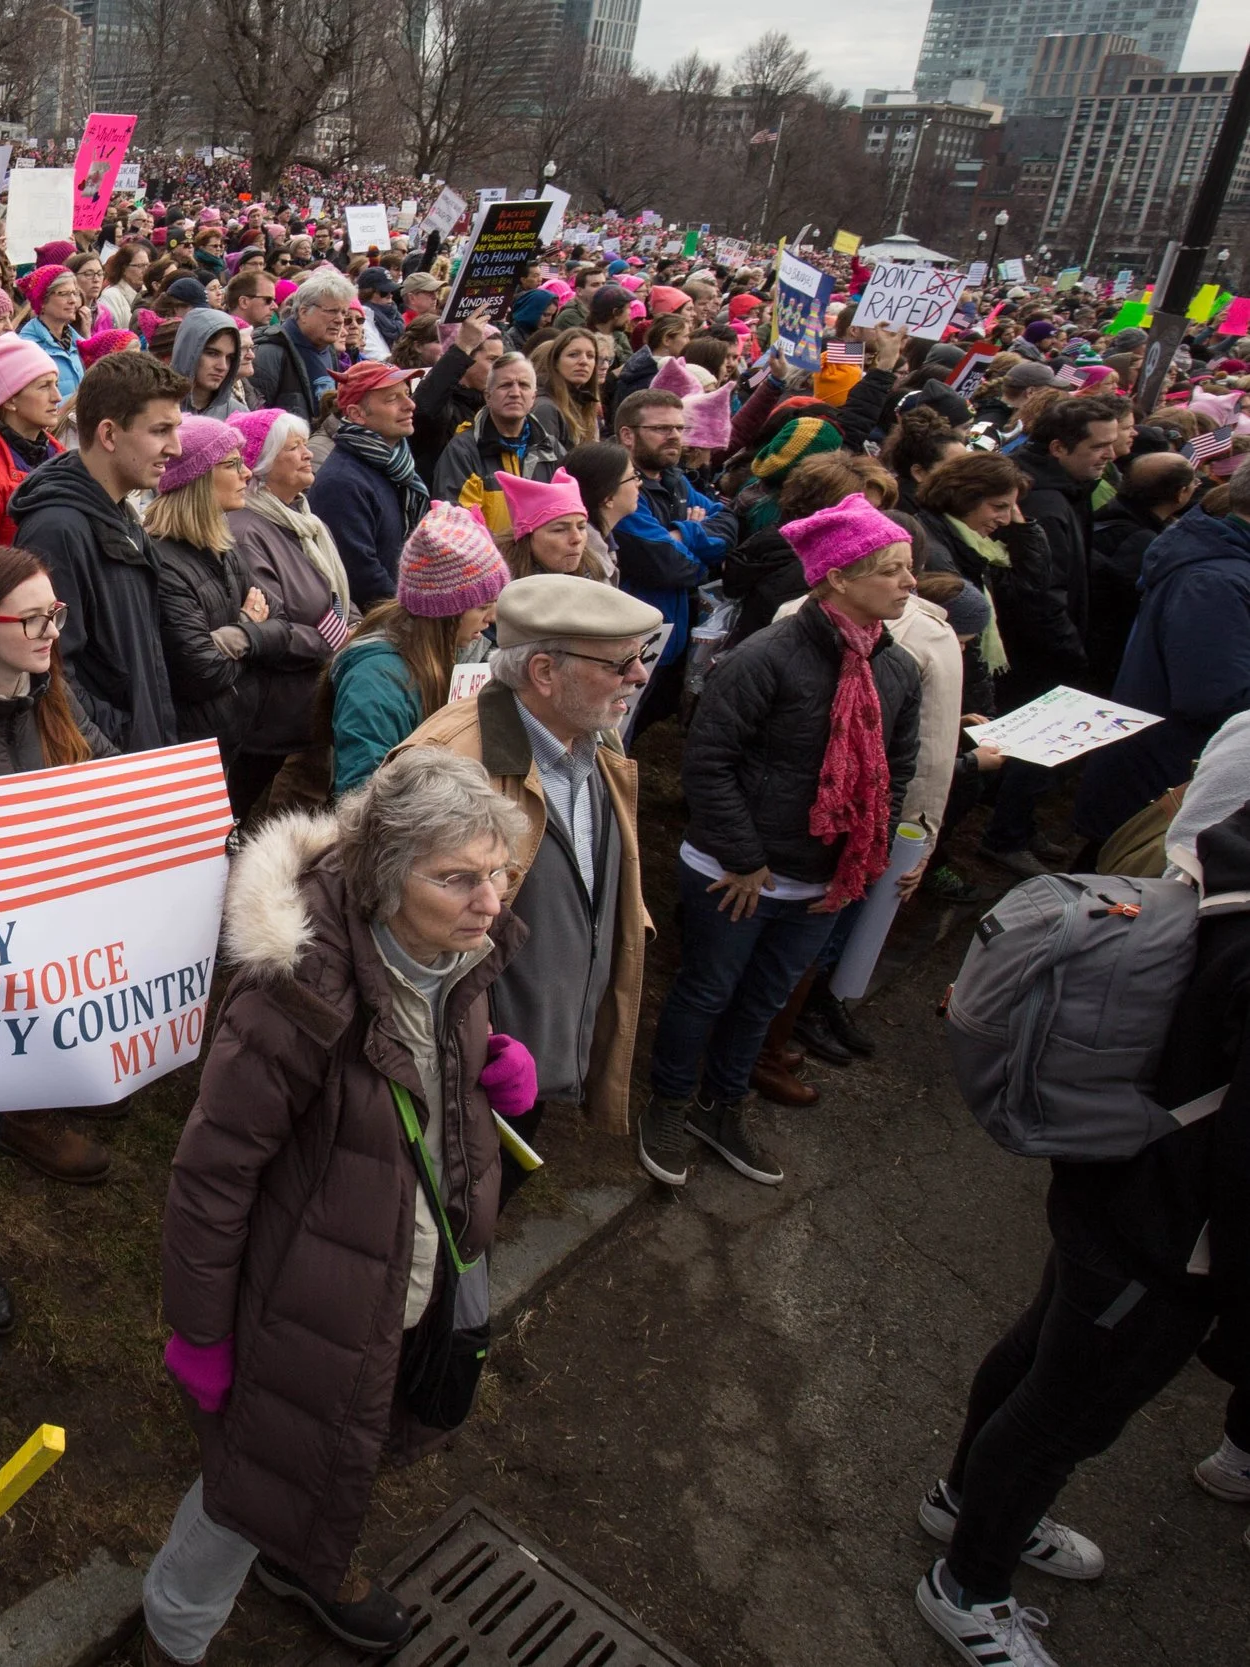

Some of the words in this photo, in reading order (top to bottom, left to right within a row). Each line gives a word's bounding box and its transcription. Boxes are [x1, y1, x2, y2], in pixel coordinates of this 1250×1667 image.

[495, 221, 531, 231] MATTER
[474, 243, 487, 252] ARE
[472, 253, 489, 264] NO
[491, 251, 527, 262] HUMAN
[472, 267, 481, 277] IS
[482, 265, 515, 276] ILLEGAL
[871, 265, 925, 290] DON'T
[459, 296, 504, 308] KINDNESS
[864, 292, 942, 328] RAPED
[53, 957, 211, 1050] COUNTRY
[110, 1025, 162, 1084] MY
